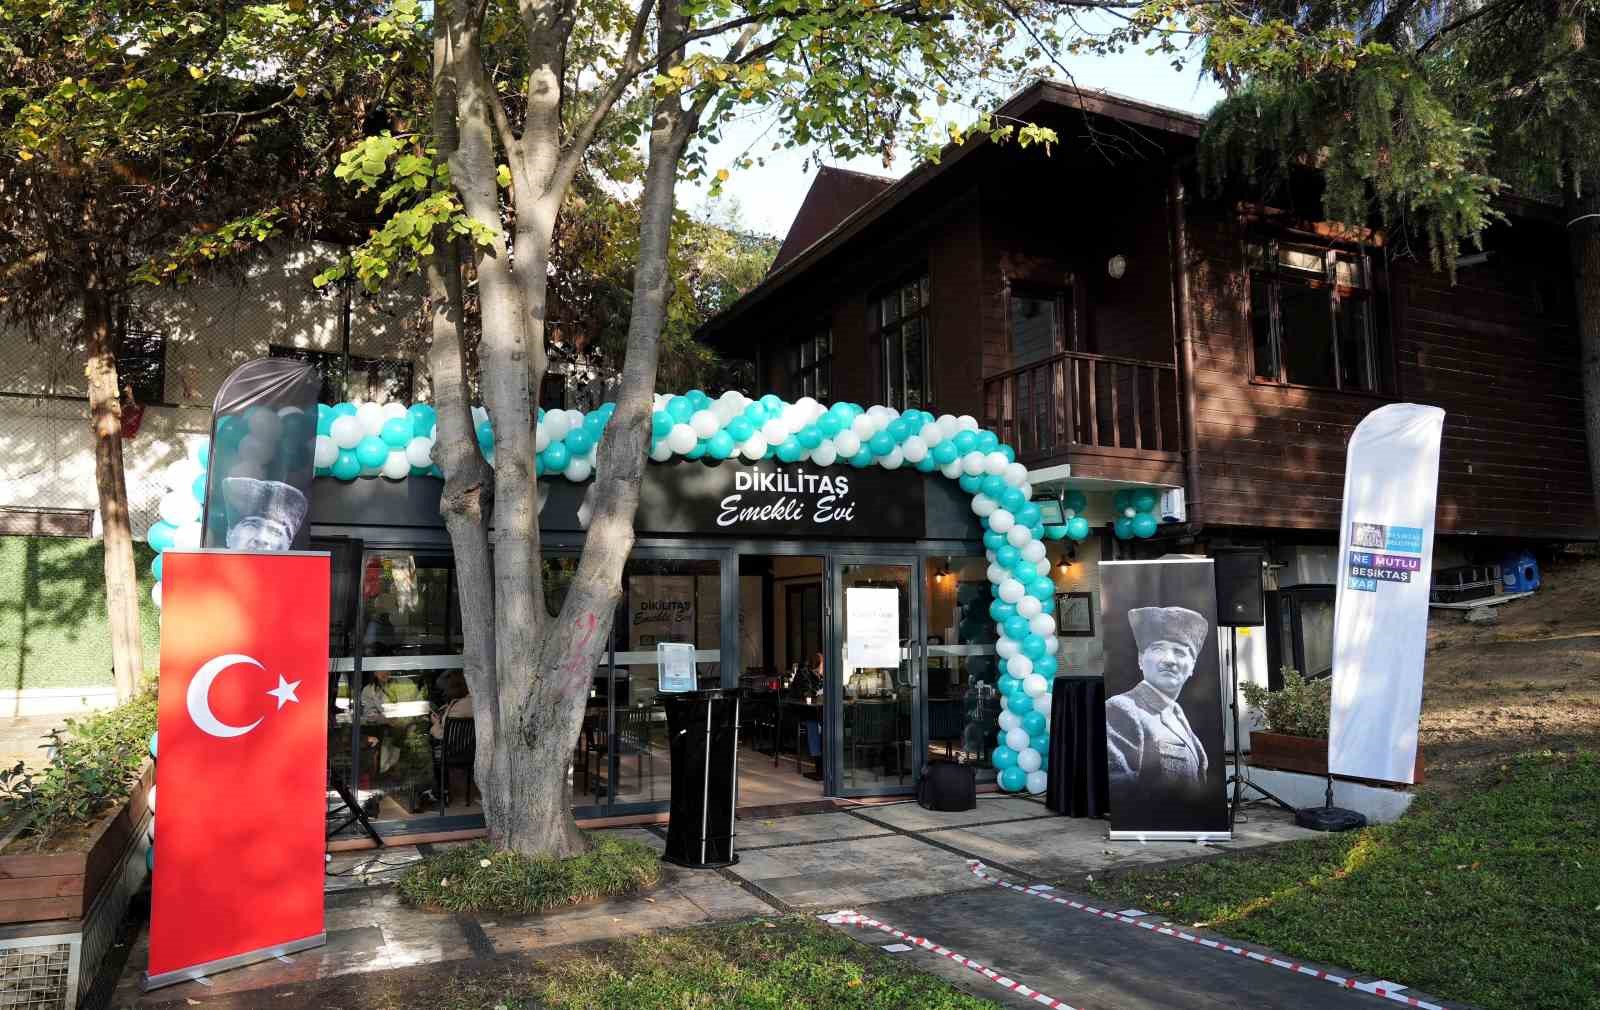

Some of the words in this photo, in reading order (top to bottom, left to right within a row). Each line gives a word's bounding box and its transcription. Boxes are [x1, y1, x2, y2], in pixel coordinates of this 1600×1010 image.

[735, 466, 849, 498] DİKİLİTAŞ
[716, 494, 804, 527] Emekli
[813, 495, 855, 523] Evi
[1353, 554, 1369, 564] NE
[1375, 556, 1417, 568] MUTLU
